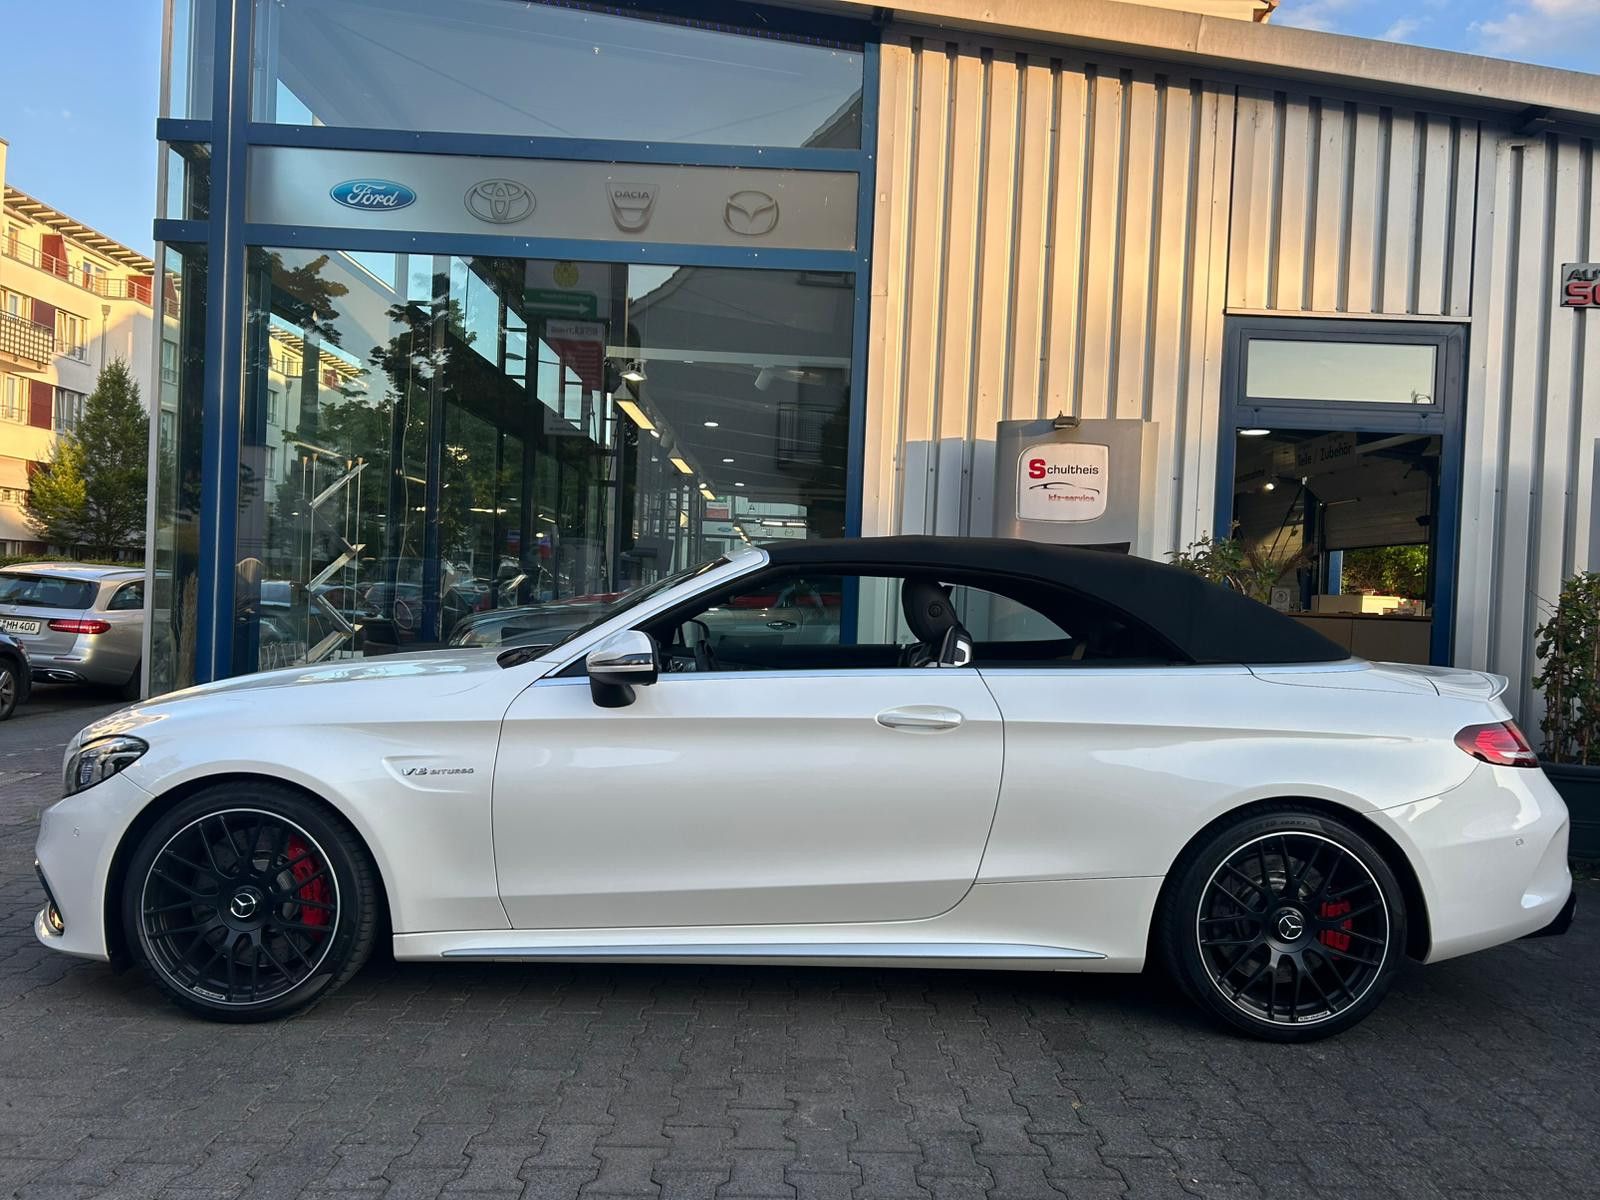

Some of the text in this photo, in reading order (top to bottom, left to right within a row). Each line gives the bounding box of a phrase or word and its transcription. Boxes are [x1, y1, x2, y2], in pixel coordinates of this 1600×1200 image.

[347, 183, 400, 206] Ford
[614, 190, 650, 200] DACIA
[1028, 458, 1100, 479] Schultheis
[1048, 493, 1096, 503] kfz-service
[19, 622, 36, 631] 400
[401, 767, 475, 776] V8 BITURBO
